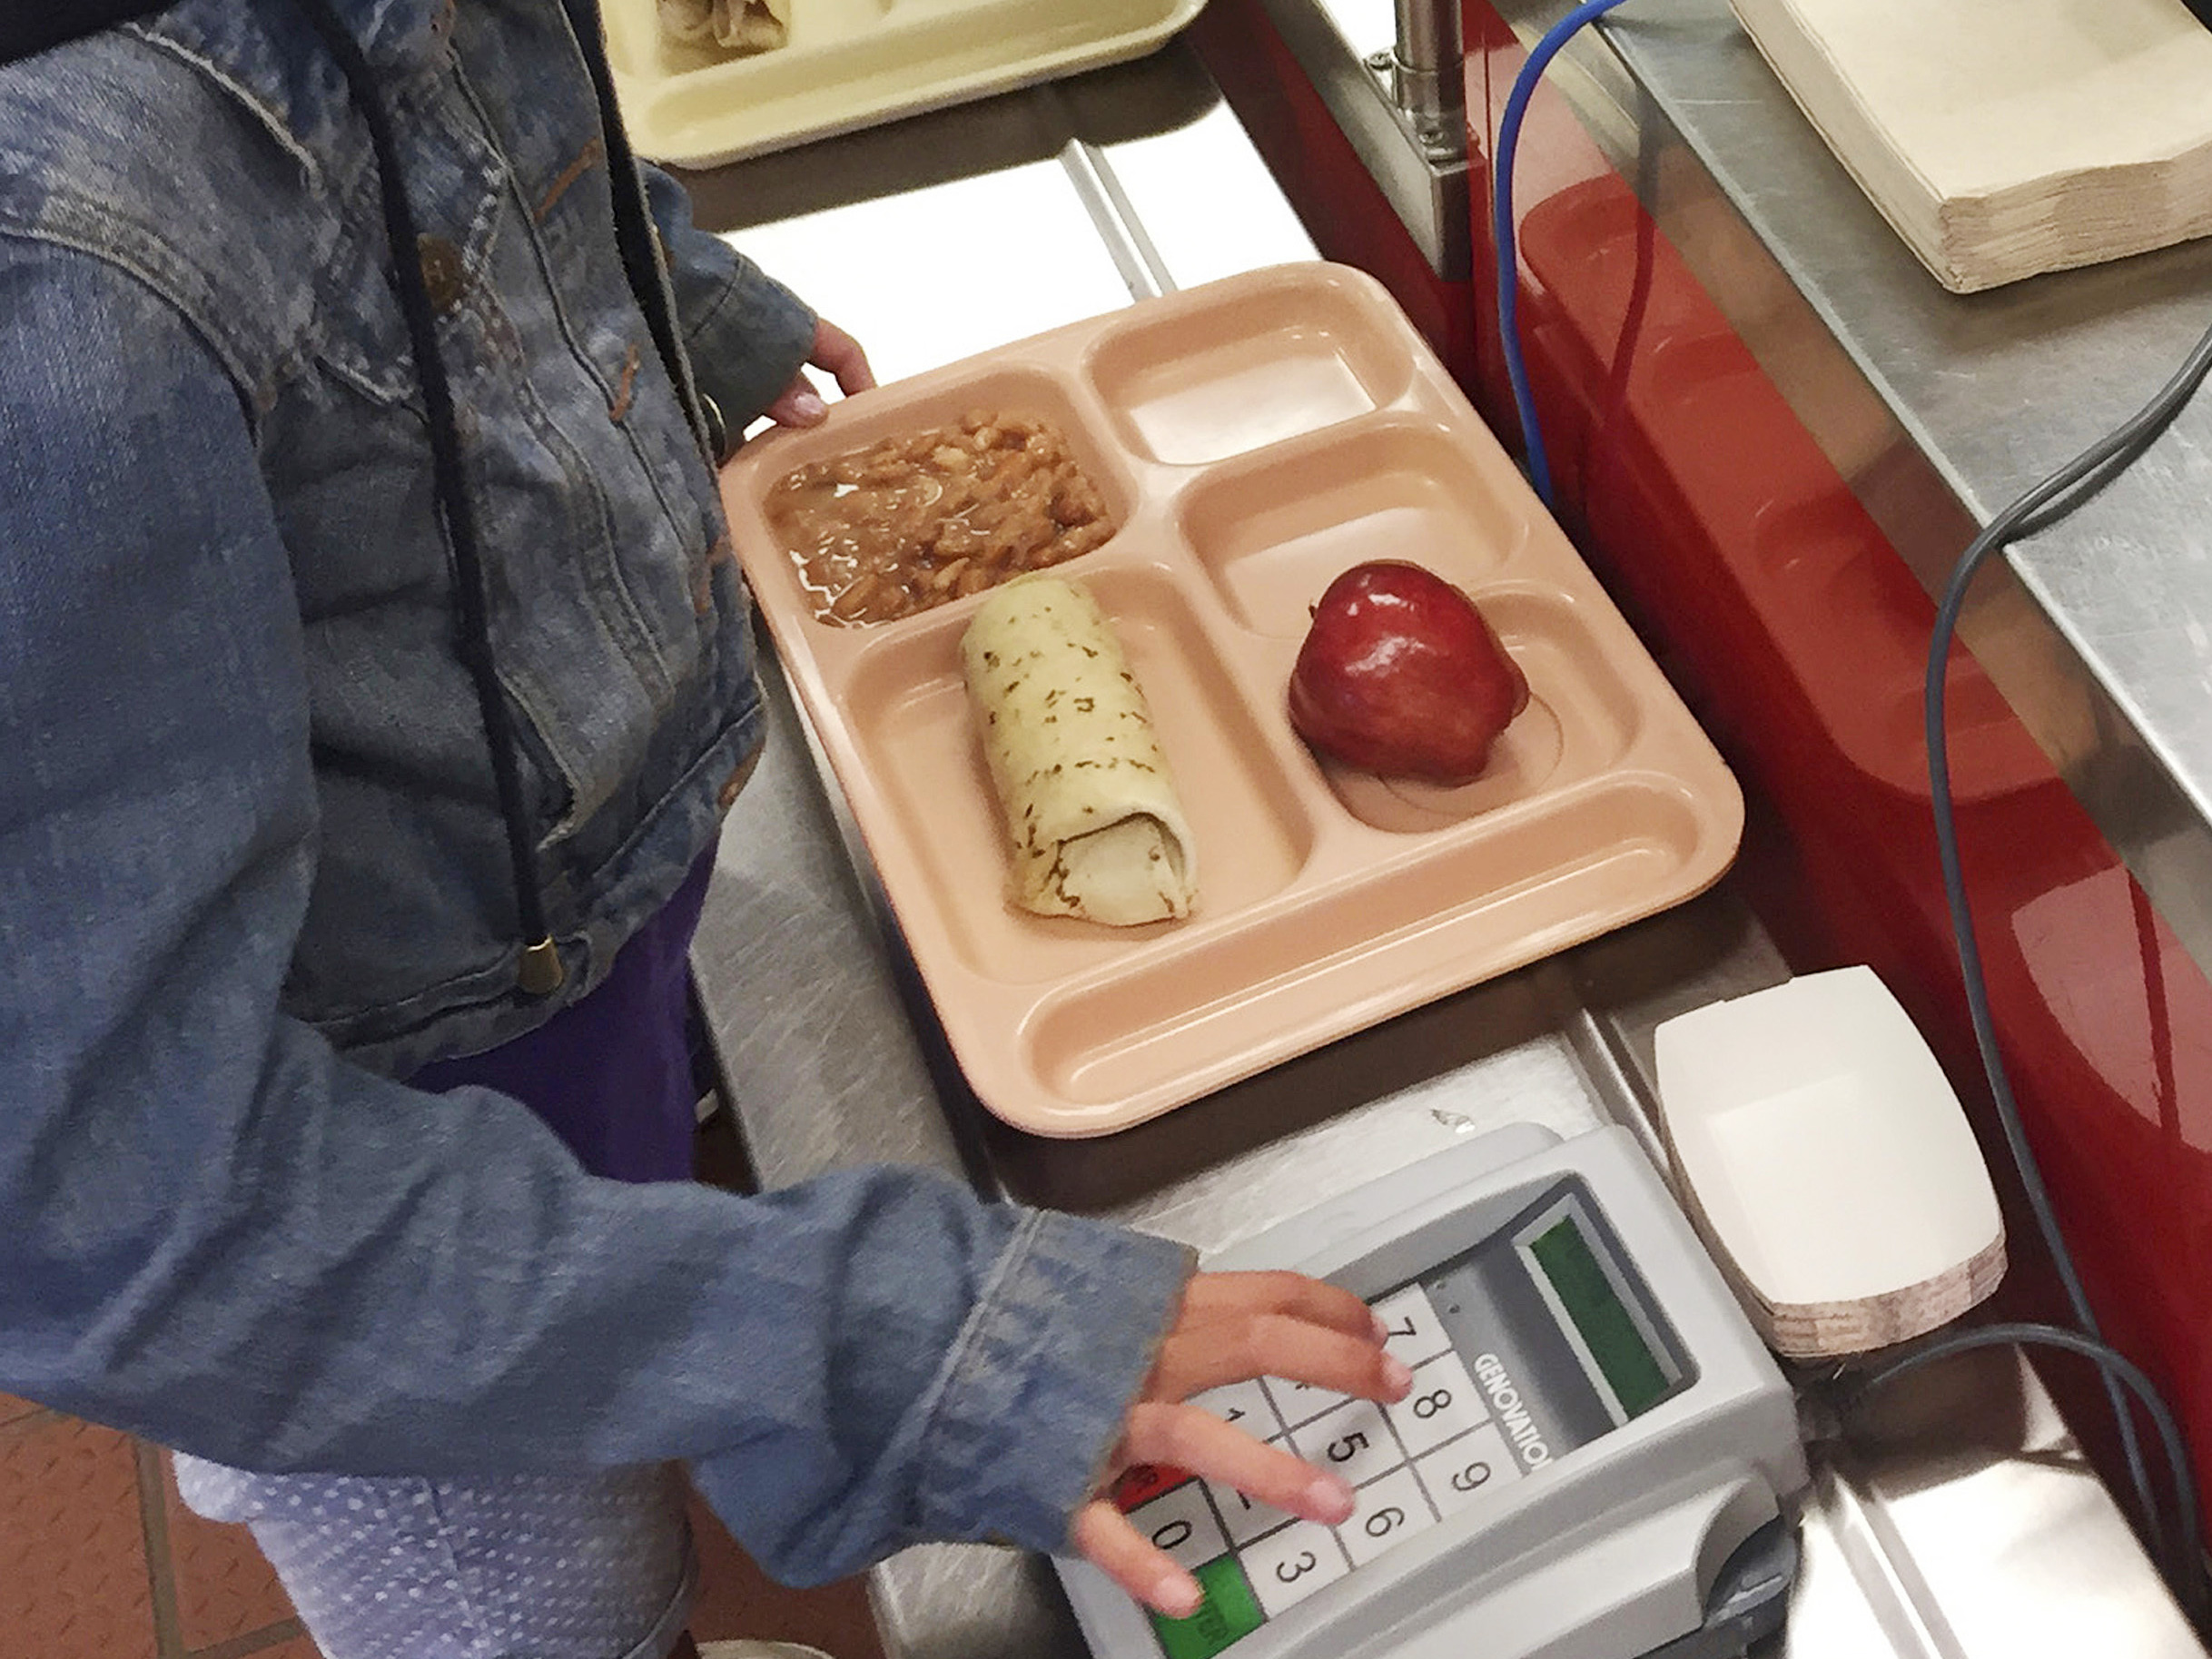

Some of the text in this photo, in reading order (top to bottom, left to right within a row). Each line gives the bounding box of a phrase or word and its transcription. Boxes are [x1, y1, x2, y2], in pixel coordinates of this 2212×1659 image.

[1386, 1317, 1417, 1337] 7
[1413, 1388, 1452, 1419] 8
[1327, 1431, 1369, 1462] 5
[1451, 1461, 1491, 1492] 9
[1152, 1519, 1192, 1550] 0
[1365, 1506, 1405, 1537] 6
[1276, 1550, 1316, 1583] 3
